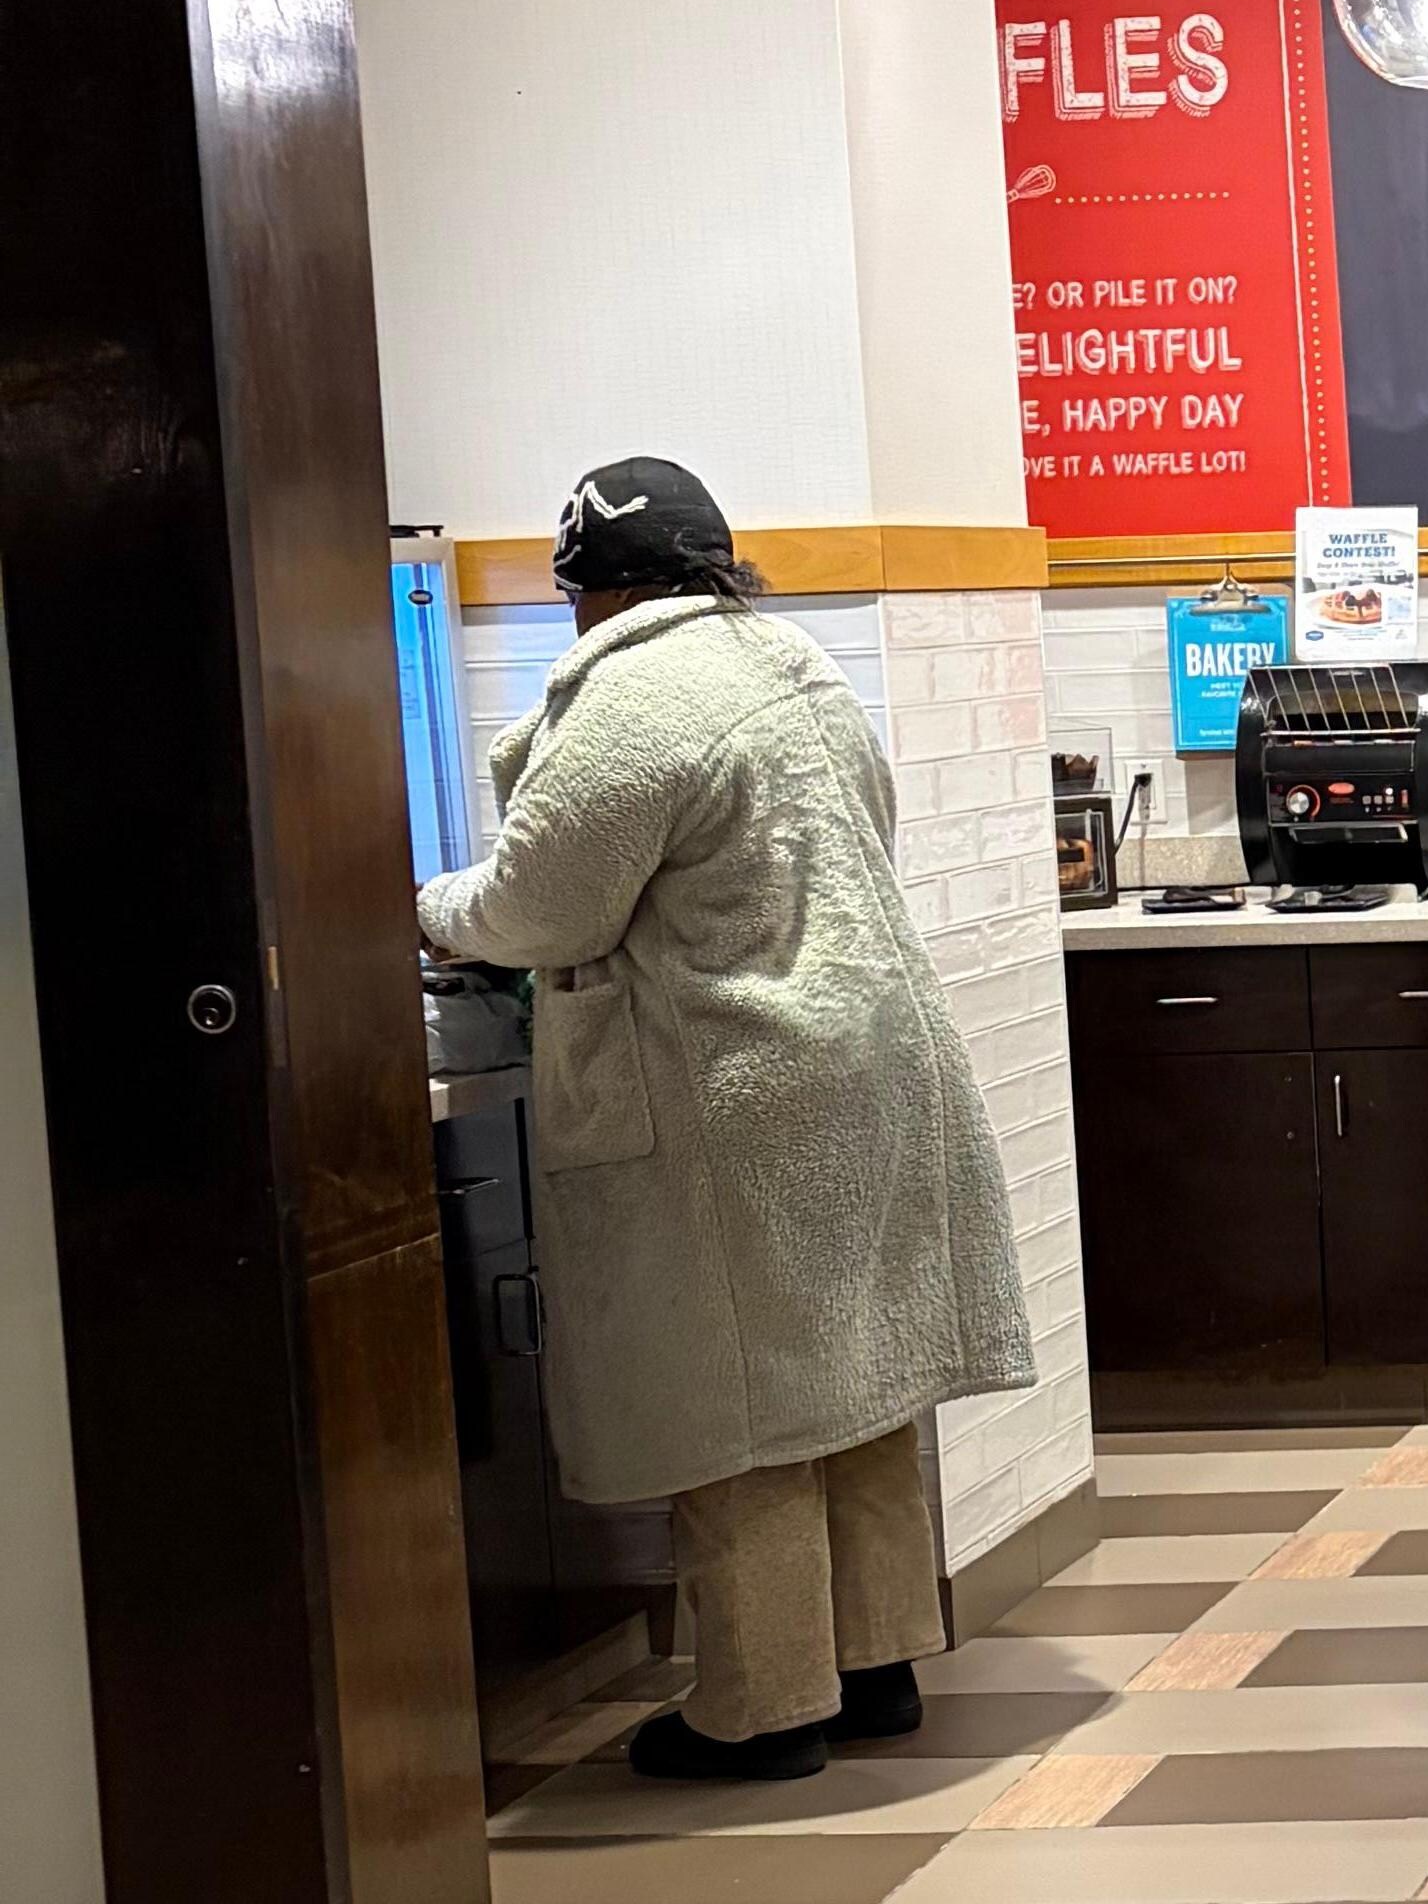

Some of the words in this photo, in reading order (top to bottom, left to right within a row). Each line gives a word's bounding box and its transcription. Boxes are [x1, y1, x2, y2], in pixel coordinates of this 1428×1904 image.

[997, 13, 1229, 122] FLES
[1047, 281, 1084, 309] OR
[1094, 279, 1147, 308] PILE
[1155, 278, 1178, 306] IT
[1188, 275, 1238, 304] ON?
[1015, 326, 1243, 377] ELIGHTFUL
[1062, 396, 1168, 432] HAPPY
[1181, 393, 1244, 429] DAY
[1063, 455, 1081, 477] IT
[1089, 454, 1105, 476] A
[1112, 451, 1193, 476] WAFFLE
[1200, 450, 1246, 473] LOT!
[1322, 546, 1396, 558] CONTEST!
[1328, 533, 1388, 544] WAFFLE
[1185, 642, 1276, 677] BAKERY
